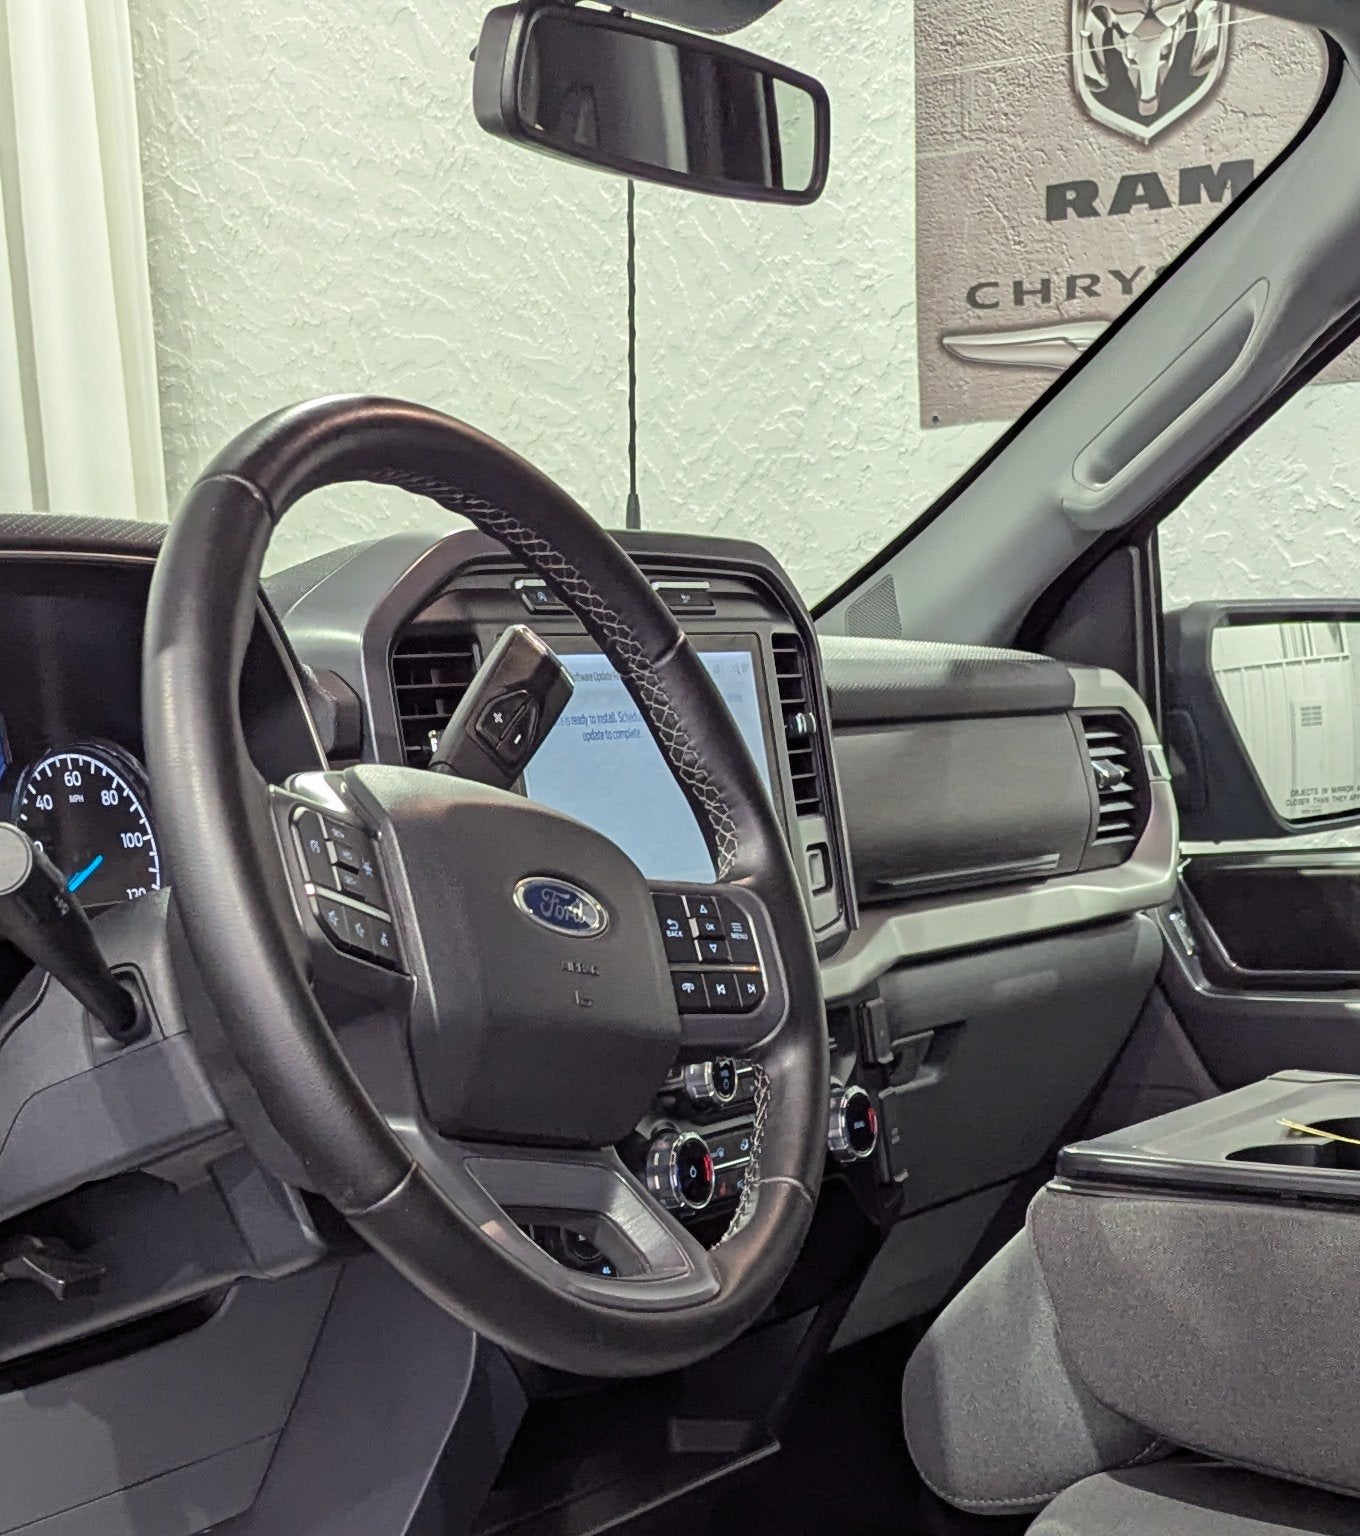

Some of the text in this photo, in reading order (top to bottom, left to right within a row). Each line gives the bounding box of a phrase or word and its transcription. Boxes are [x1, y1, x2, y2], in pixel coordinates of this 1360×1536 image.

[1045, 158, 1254, 222] RAM
[64, 771, 82, 787] 60
[35, 794, 54, 811] 40
[68, 794, 85, 803] MPH
[100, 790, 119, 806] 80
[120, 832, 144, 849] 100
[540, 888, 585, 923] Ford
